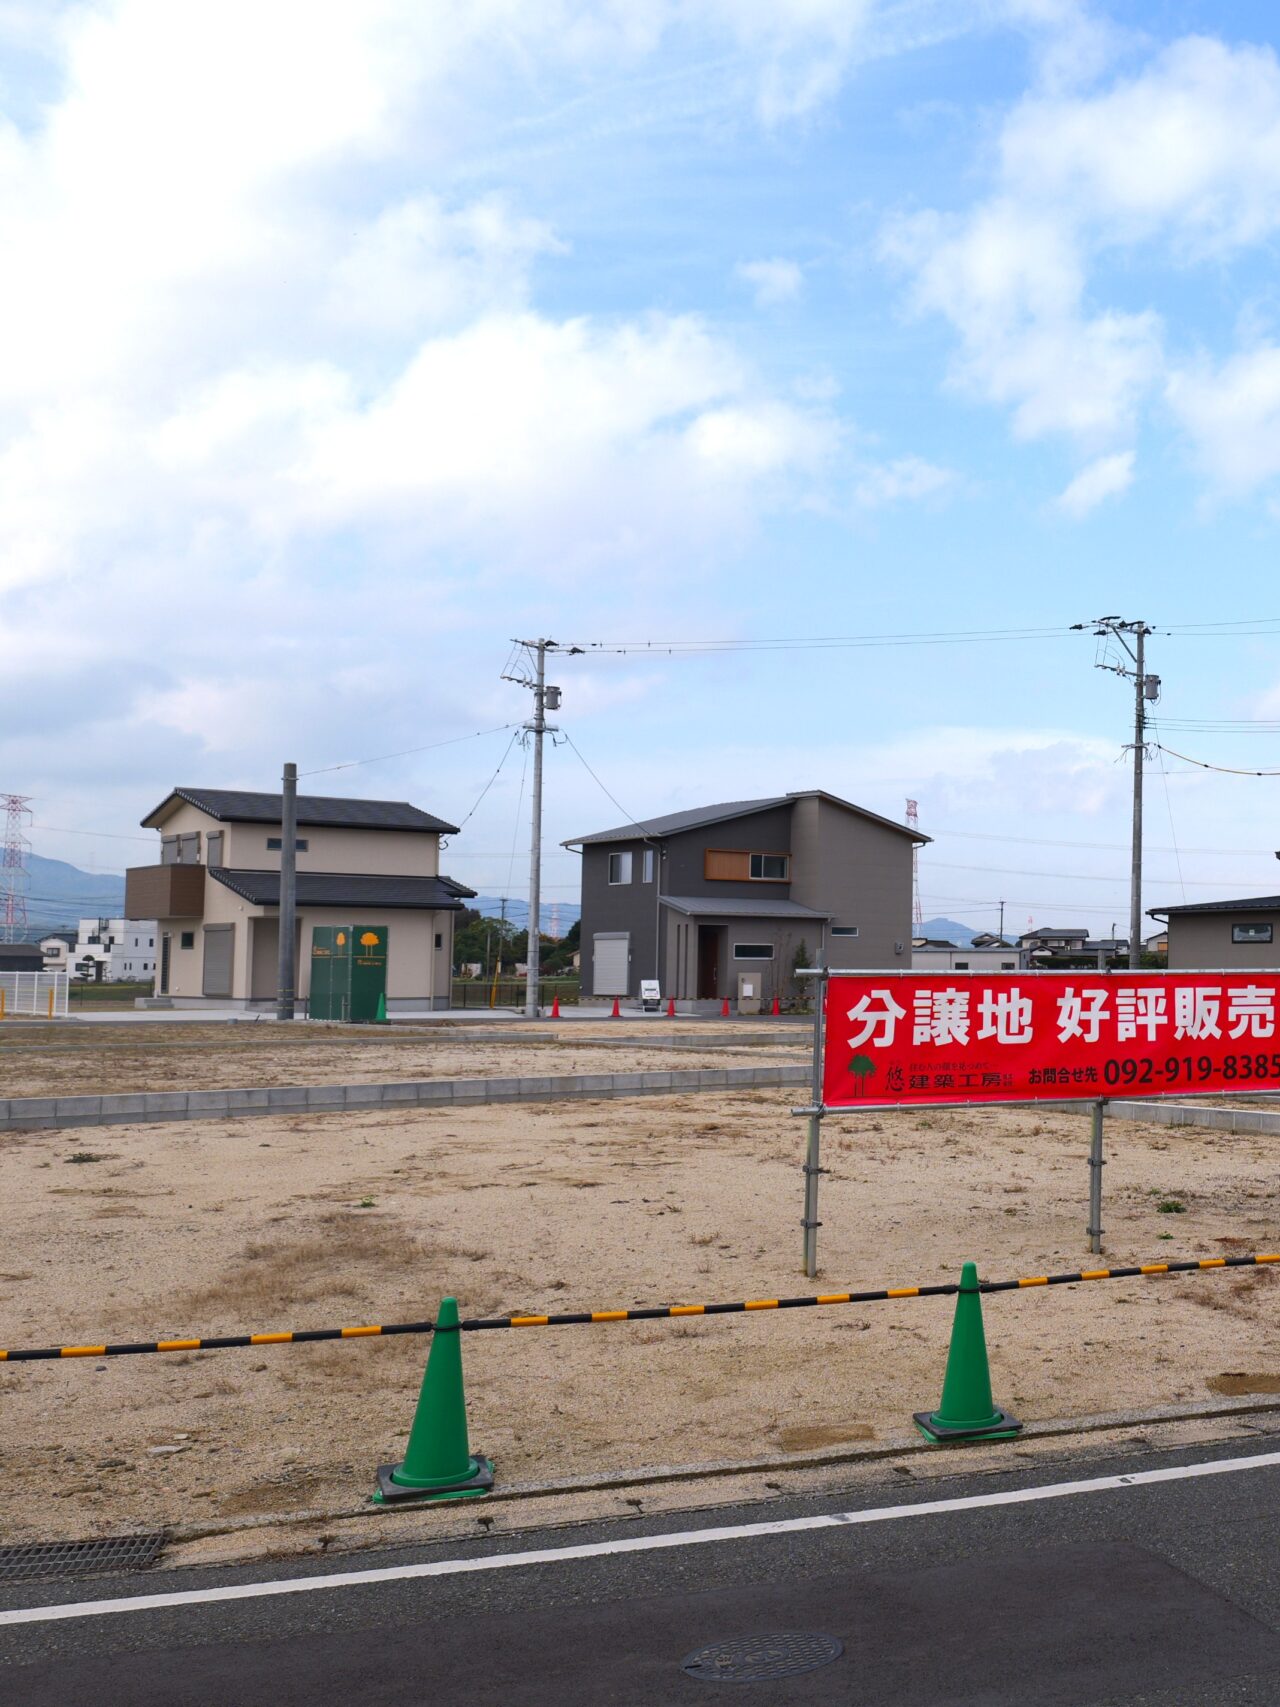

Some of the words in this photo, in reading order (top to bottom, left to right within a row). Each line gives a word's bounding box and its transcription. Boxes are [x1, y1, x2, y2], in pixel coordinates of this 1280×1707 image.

[846, 986, 1033, 1049] 分譲地
[908, 1071, 1002, 1090] 建築工房
[1028, 1066, 1098, 1085] お問合せ先
